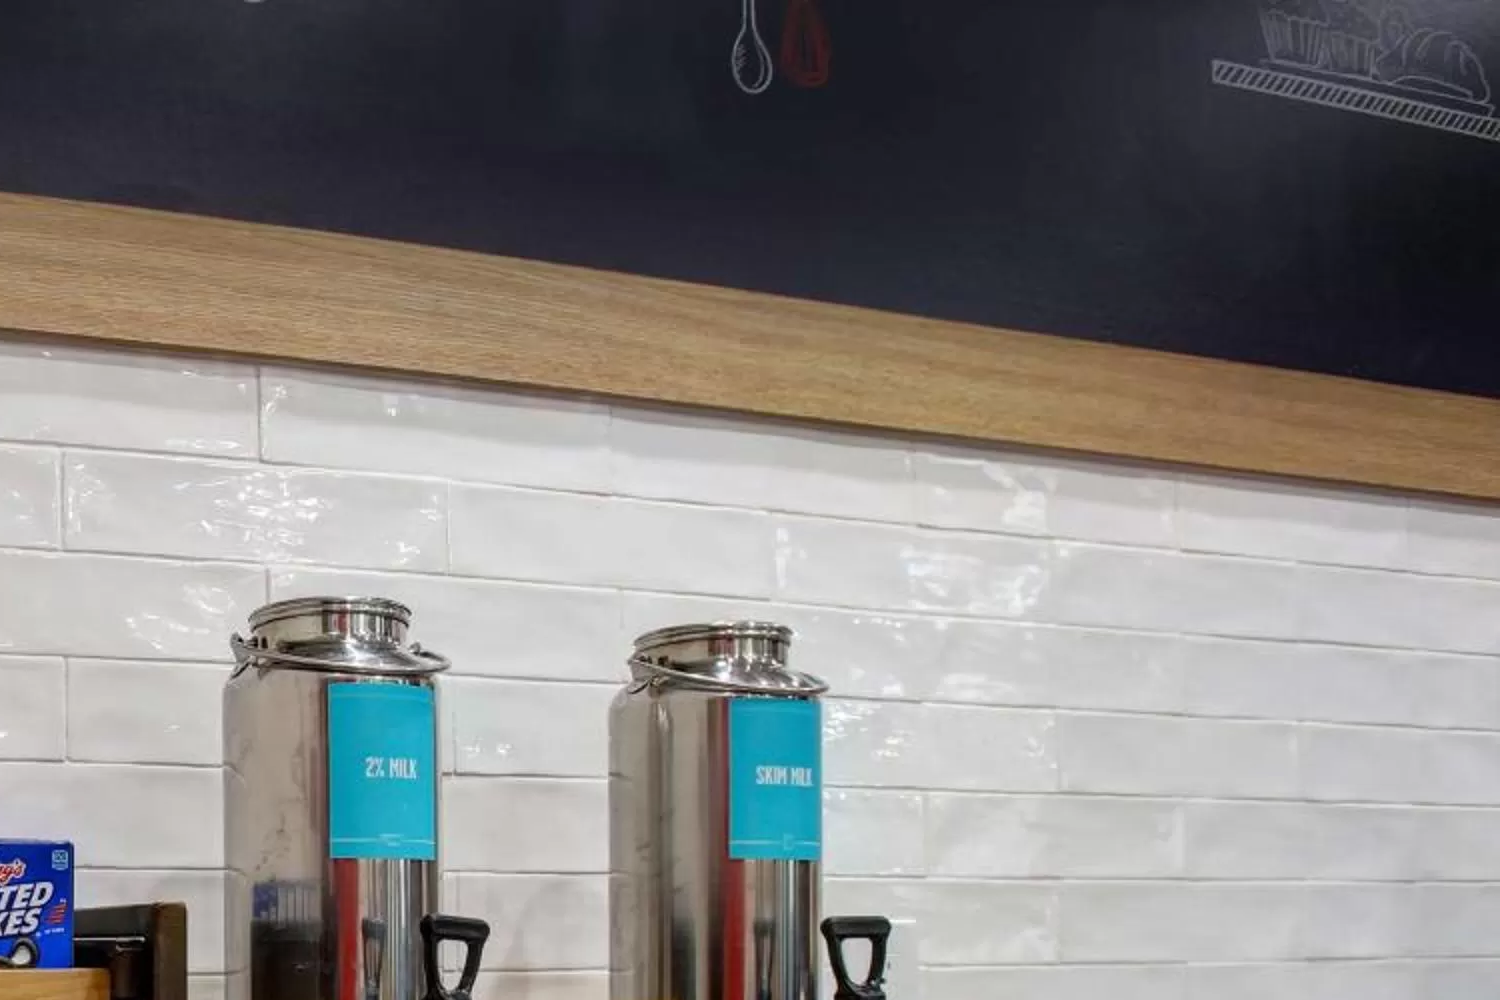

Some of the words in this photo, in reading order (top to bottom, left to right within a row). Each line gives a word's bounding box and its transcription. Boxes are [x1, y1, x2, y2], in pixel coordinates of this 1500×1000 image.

[365, 757, 385, 778] 2%
[389, 757, 418, 780] MILK
[755, 765, 787, 786] SKIM
[790, 766, 814, 787] MILK
